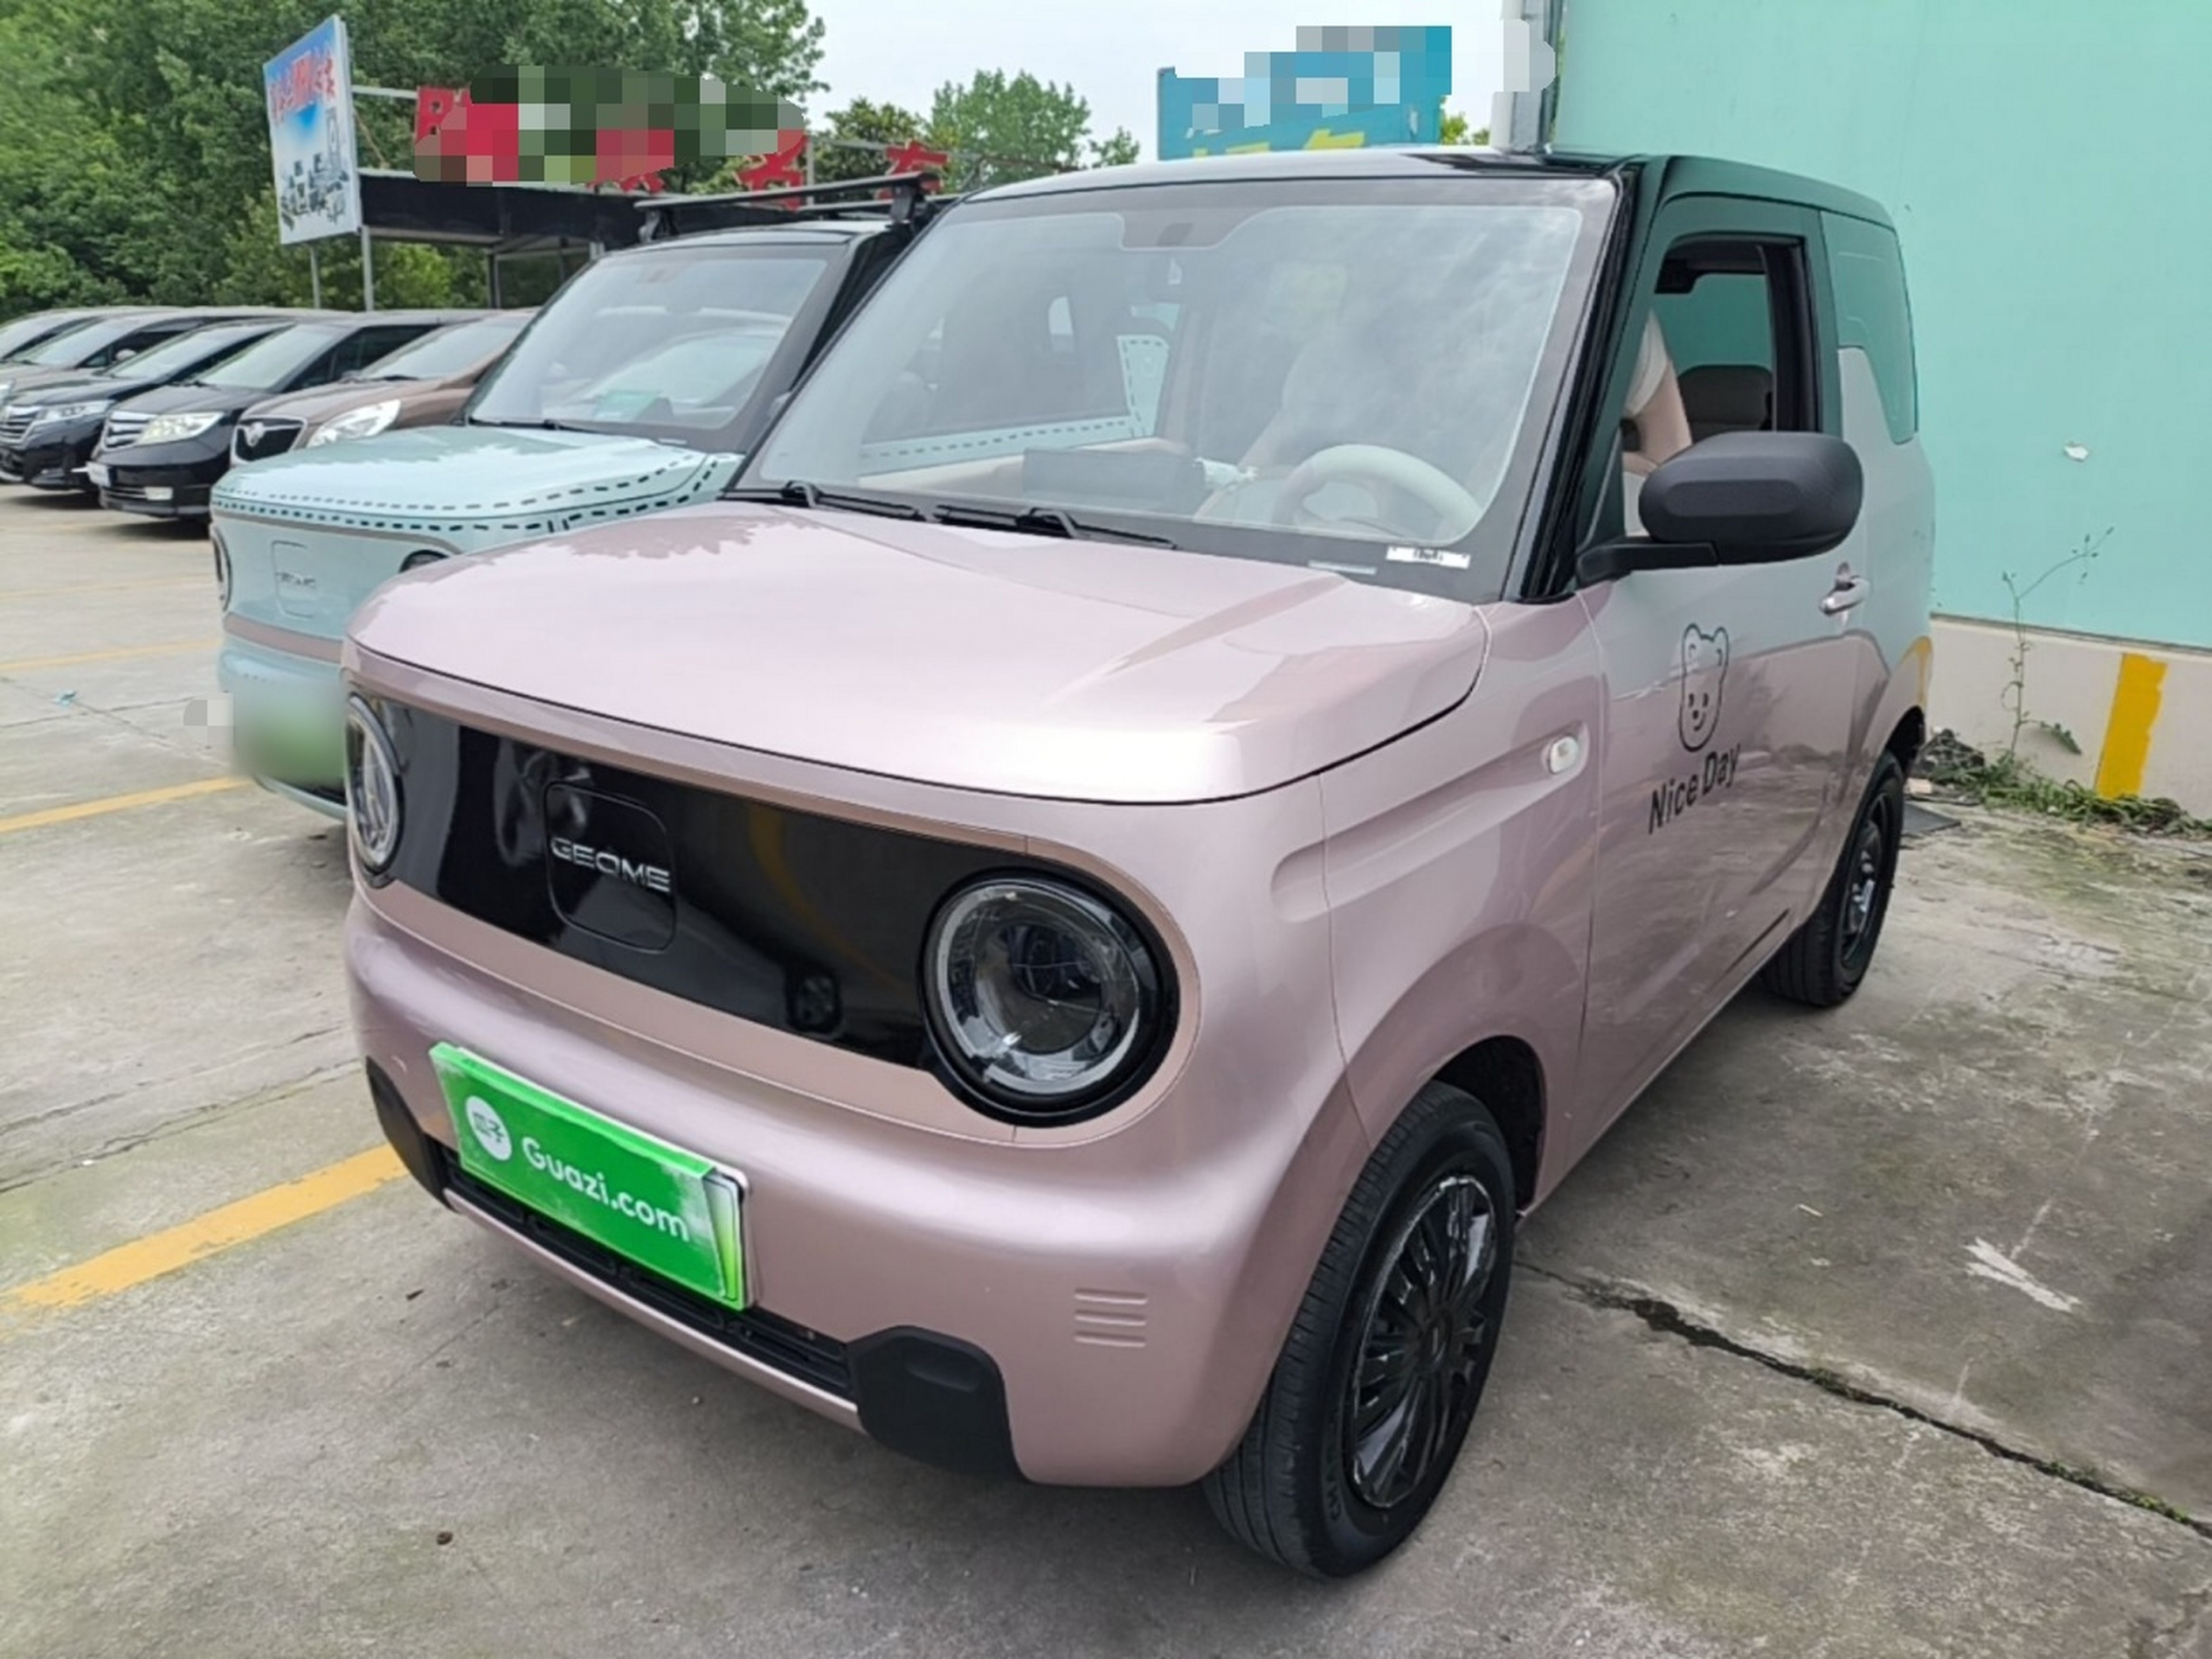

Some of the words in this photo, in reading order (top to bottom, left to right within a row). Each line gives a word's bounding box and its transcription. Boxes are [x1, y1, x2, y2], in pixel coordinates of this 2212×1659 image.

[1647, 773, 1698, 835] Nice
[1702, 743, 1741, 796] Day
[550, 836, 671, 893] GEOME
[521, 1137, 691, 1243] Guazi.com
